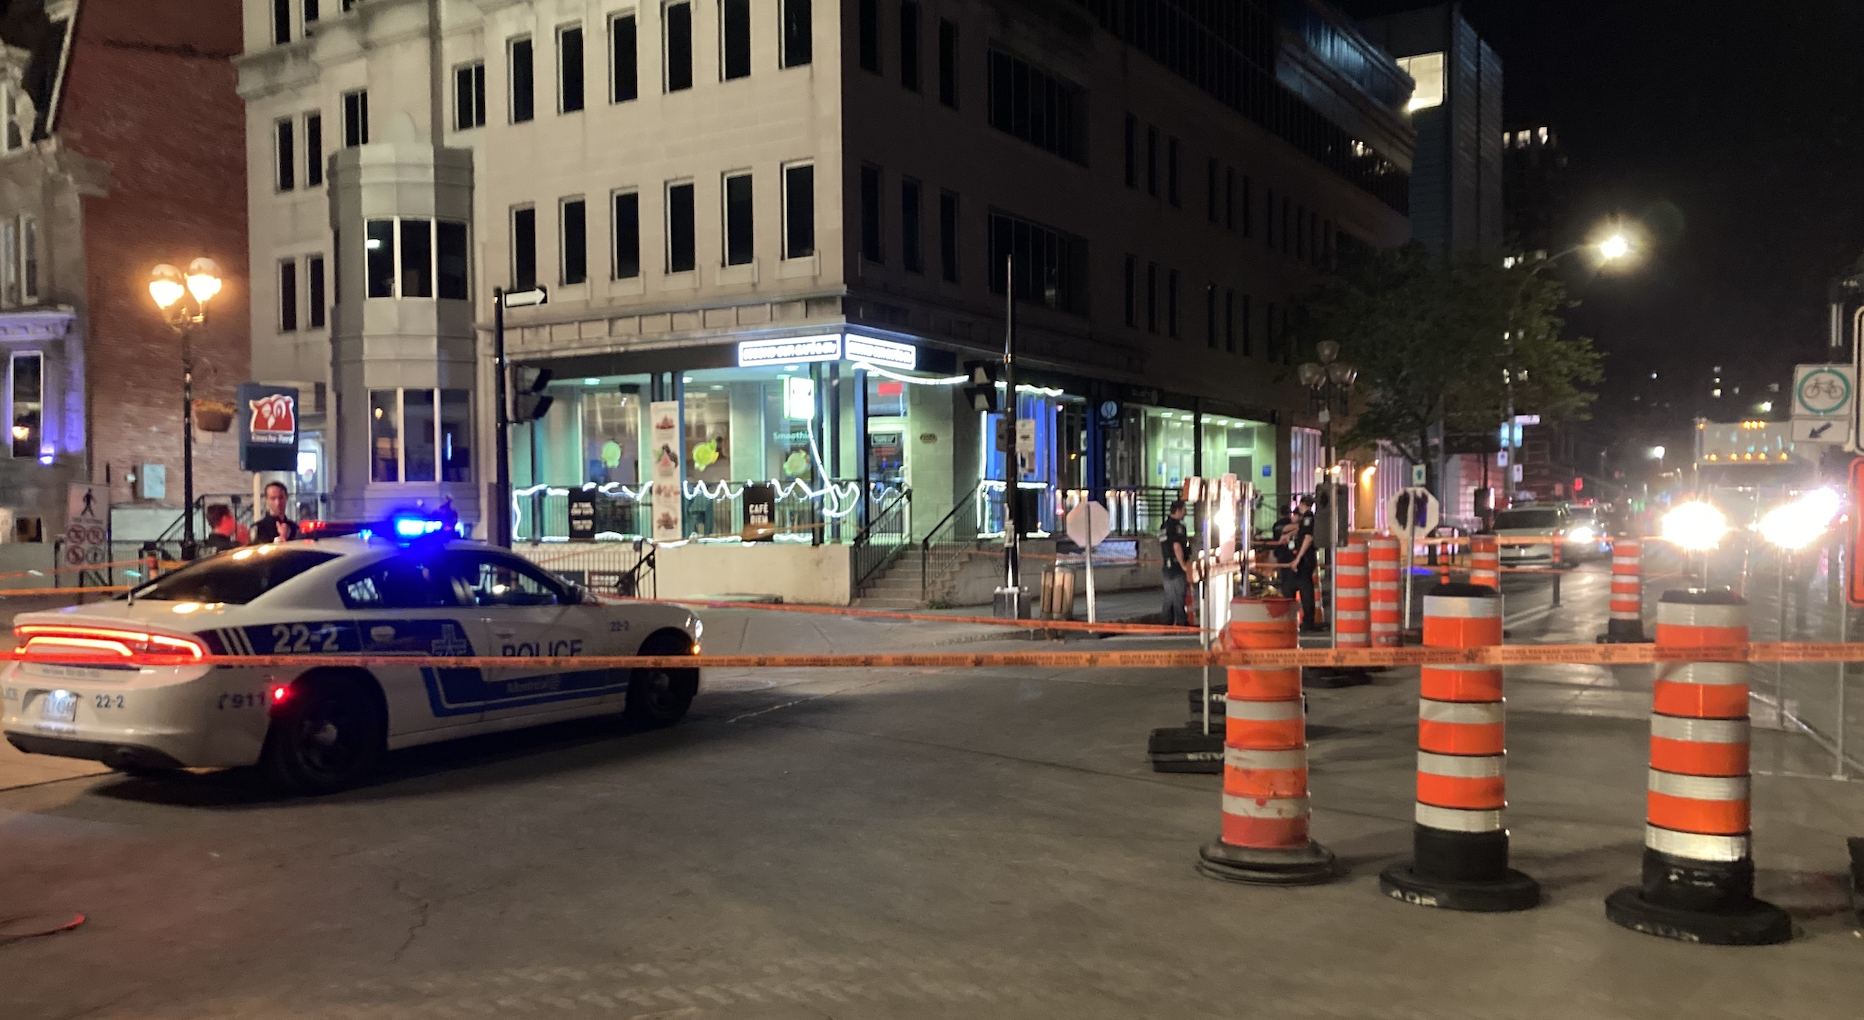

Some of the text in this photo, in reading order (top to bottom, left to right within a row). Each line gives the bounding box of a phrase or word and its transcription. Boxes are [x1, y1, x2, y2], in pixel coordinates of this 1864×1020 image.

[749, 501, 769, 514] CAFÉ
[272, 623, 340, 653] 22-2
[95, 694, 125, 708] 22-2
[231, 691, 266, 708] 911
